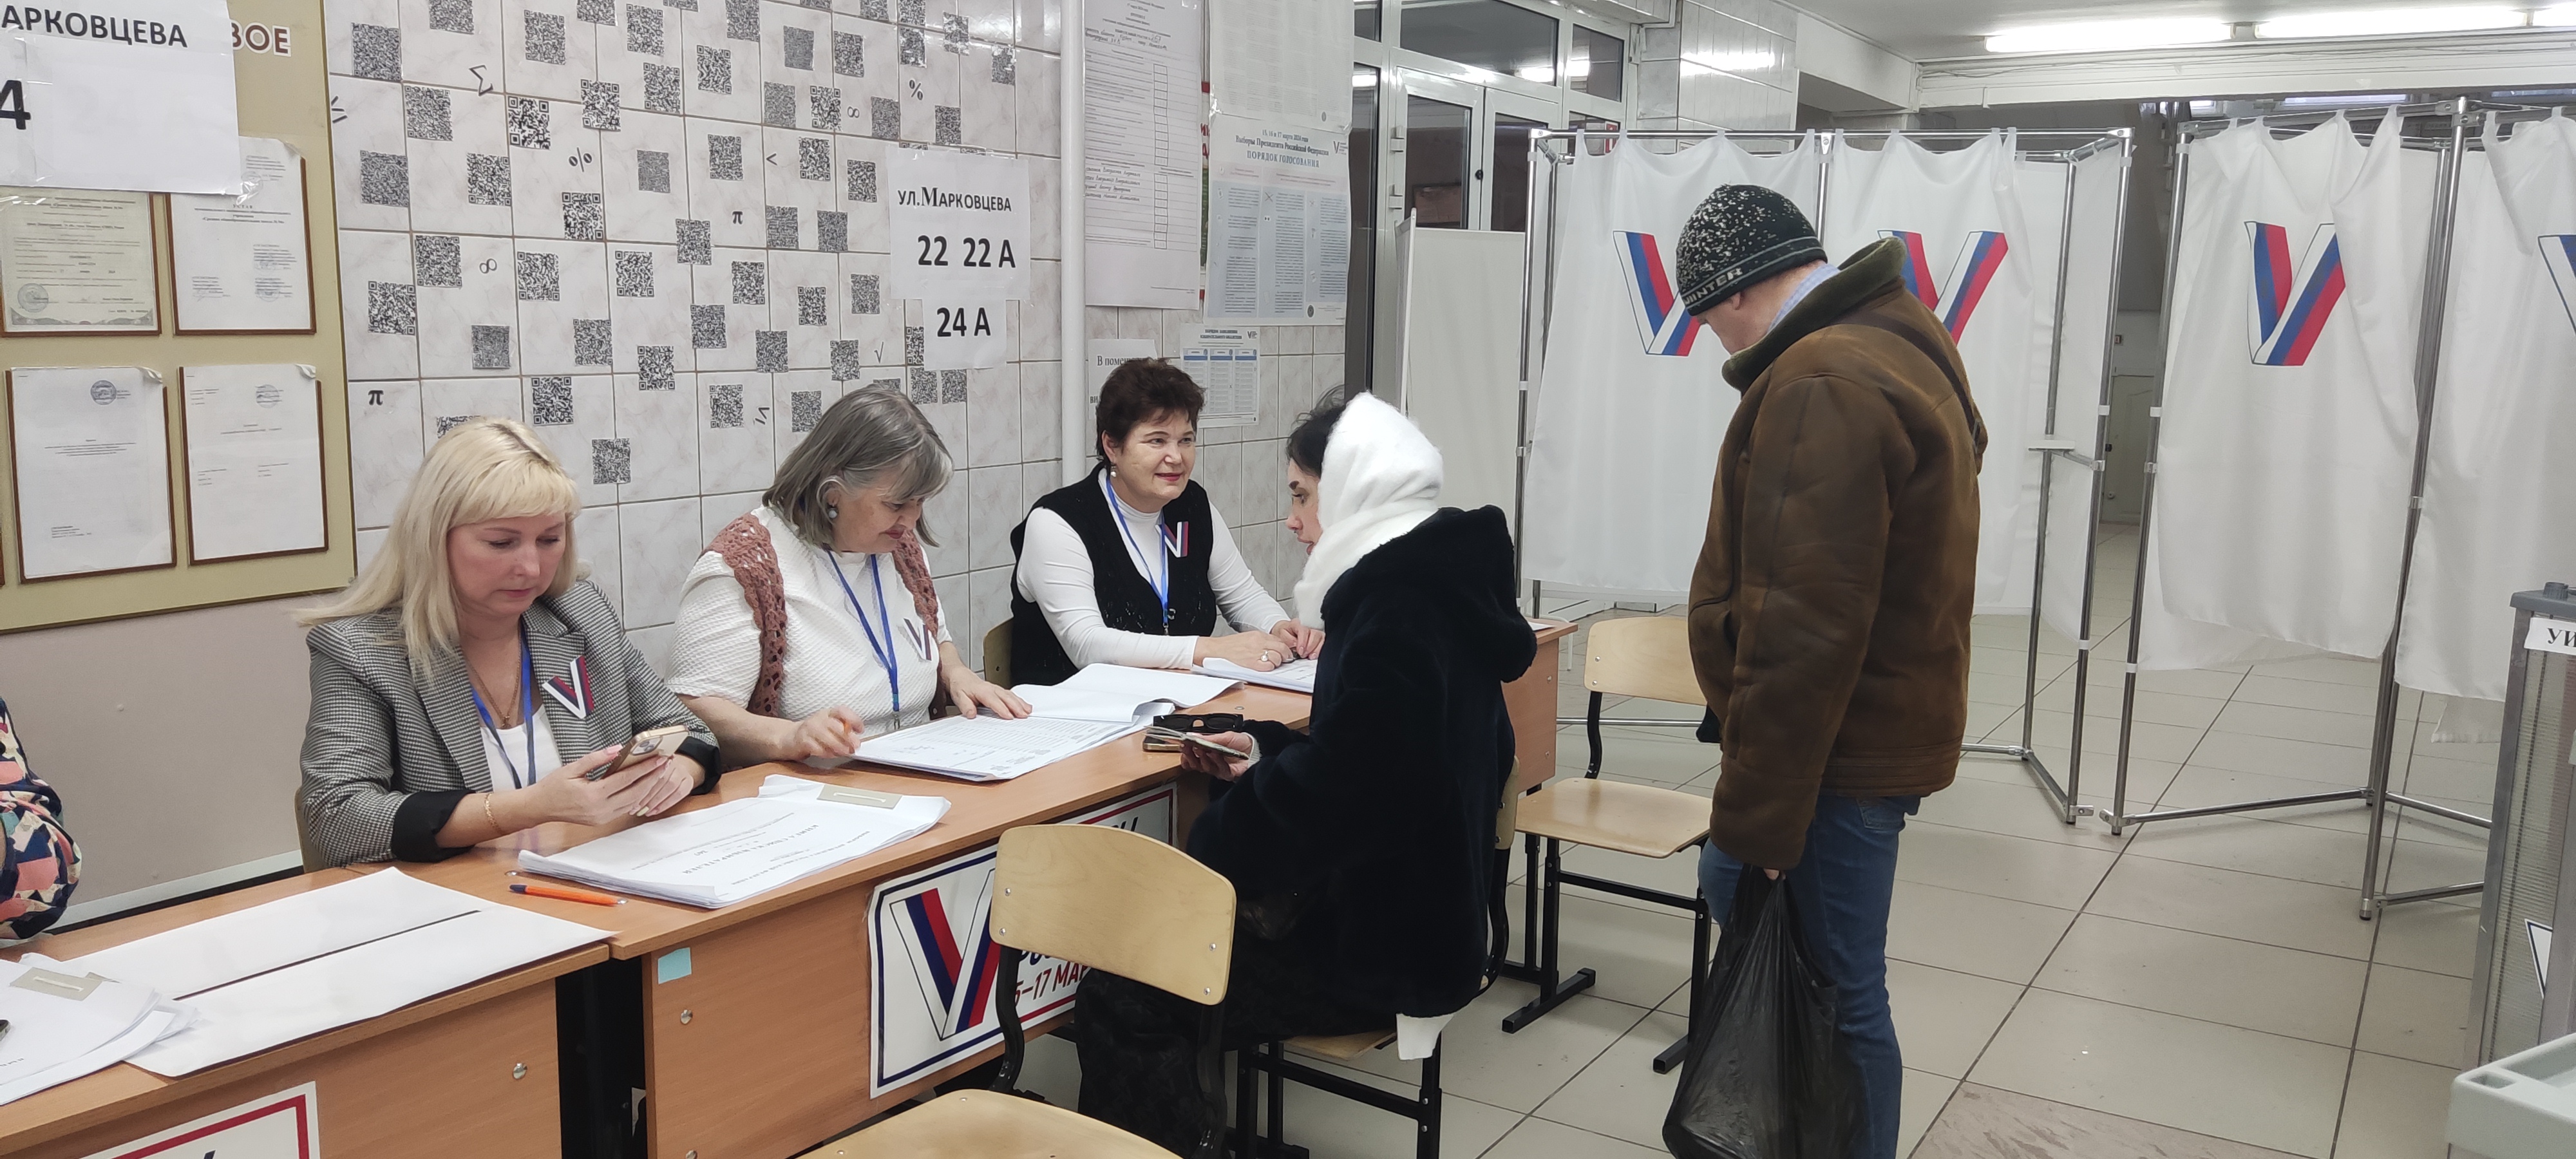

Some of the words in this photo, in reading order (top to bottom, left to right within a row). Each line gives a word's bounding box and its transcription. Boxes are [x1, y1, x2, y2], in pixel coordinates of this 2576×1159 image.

[1247, 150, 1278, 162] ПОРЯДОК
[1279, 155, 1320, 167] ГОЛОСОВАНИЯ
[918, 235, 949, 266] 22
[963, 237, 992, 267] 22
[998, 240, 1016, 268] А
[936, 307, 967, 337] 24
[974, 307, 991, 336] А
